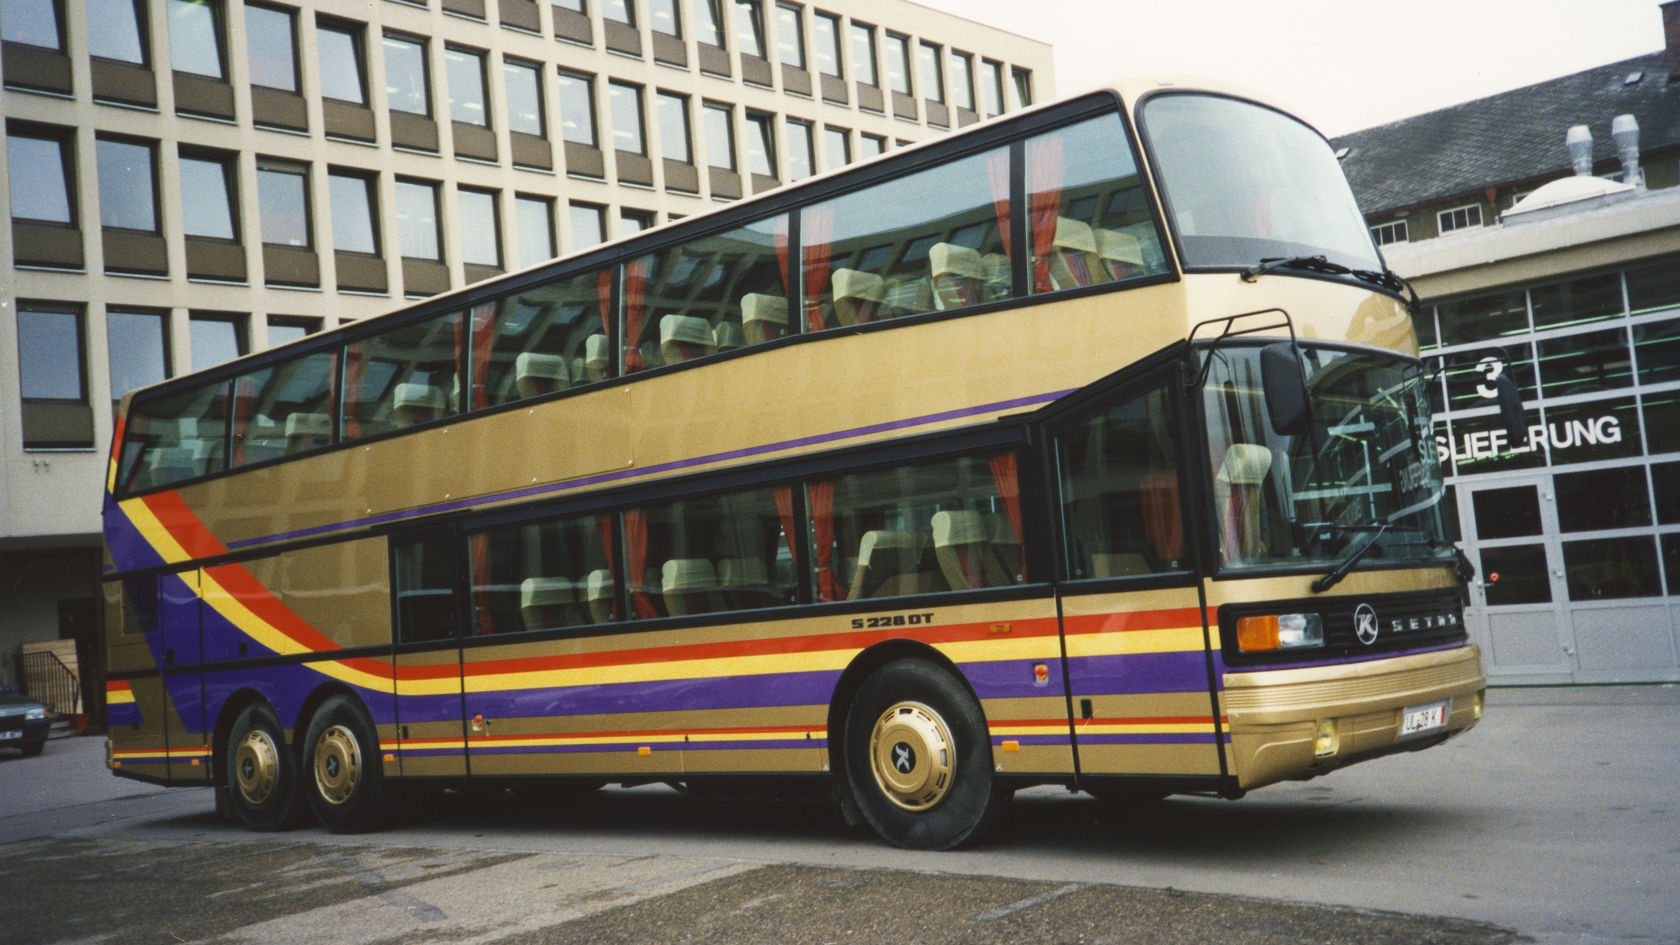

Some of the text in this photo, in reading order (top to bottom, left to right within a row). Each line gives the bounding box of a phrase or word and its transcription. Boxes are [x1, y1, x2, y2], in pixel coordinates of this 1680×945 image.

[1475, 356, 1504, 399] 3
[1435, 415, 1622, 464] SLIEFRUNG
[851, 613, 934, 630] S 228 DT
[1392, 614, 1457, 632] SETRA
